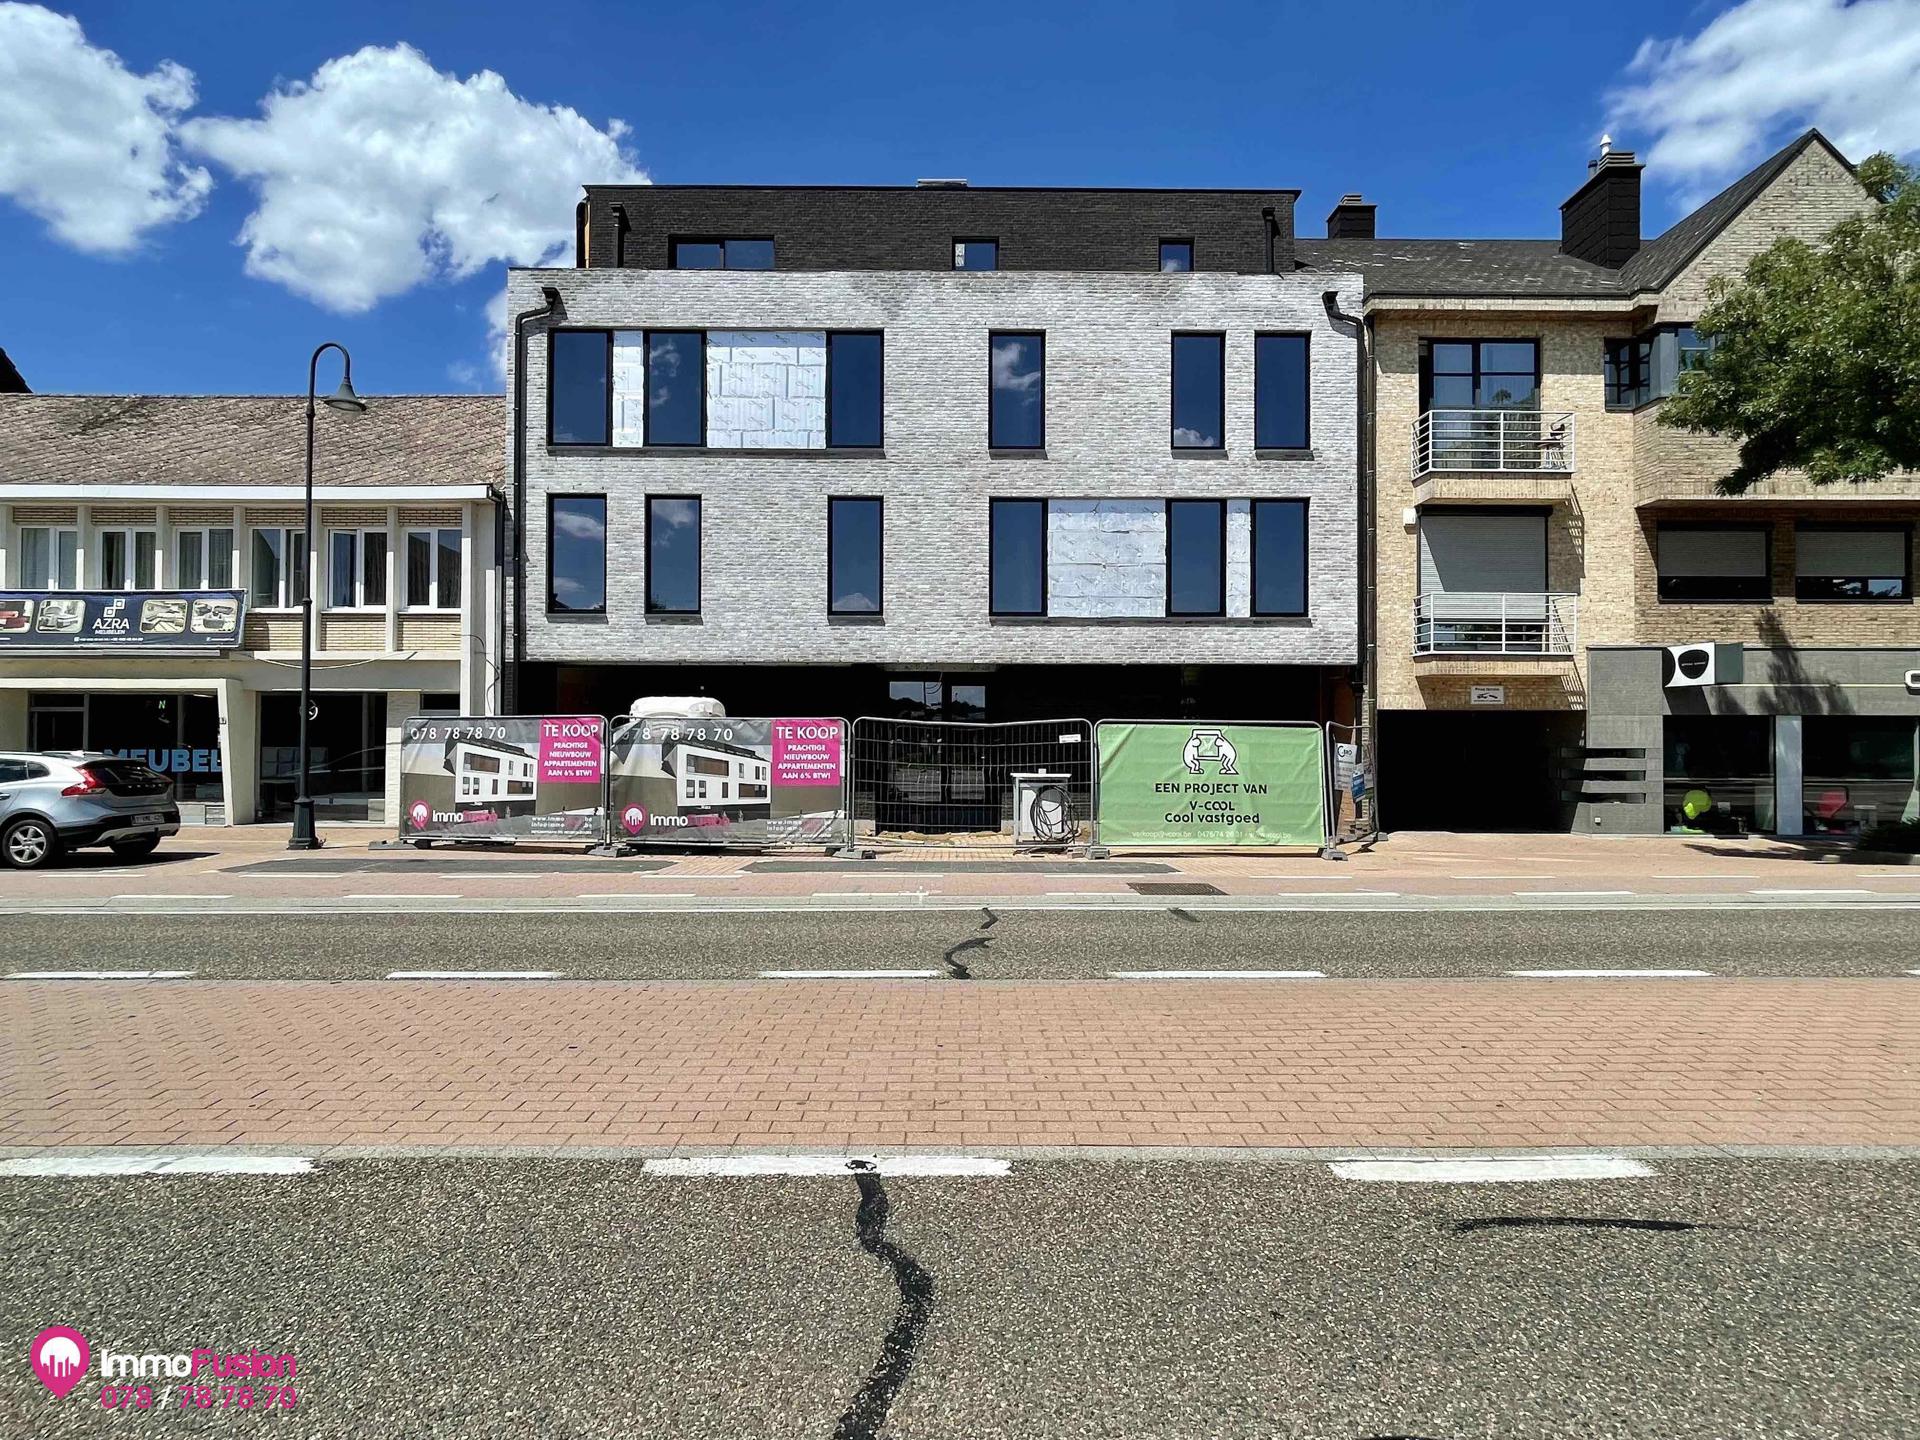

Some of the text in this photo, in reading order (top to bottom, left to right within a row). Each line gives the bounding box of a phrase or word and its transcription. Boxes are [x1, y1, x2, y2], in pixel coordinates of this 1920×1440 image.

[92, 618, 130, 629] AZRA
[410, 726, 506, 740] 078 78 78 70
[544, 724, 598, 737] TE KOOP
[661, 728, 680, 740] 78
[686, 728, 706, 740] 78
[714, 728, 733, 740] 70
[776, 726, 839, 739] TE KOOP
[1155, 783, 1268, 795] EEN PROJECT VAN
[1190, 801, 1236, 811] V-COOL
[1164, 812, 1260, 826] Cool vastgoed
